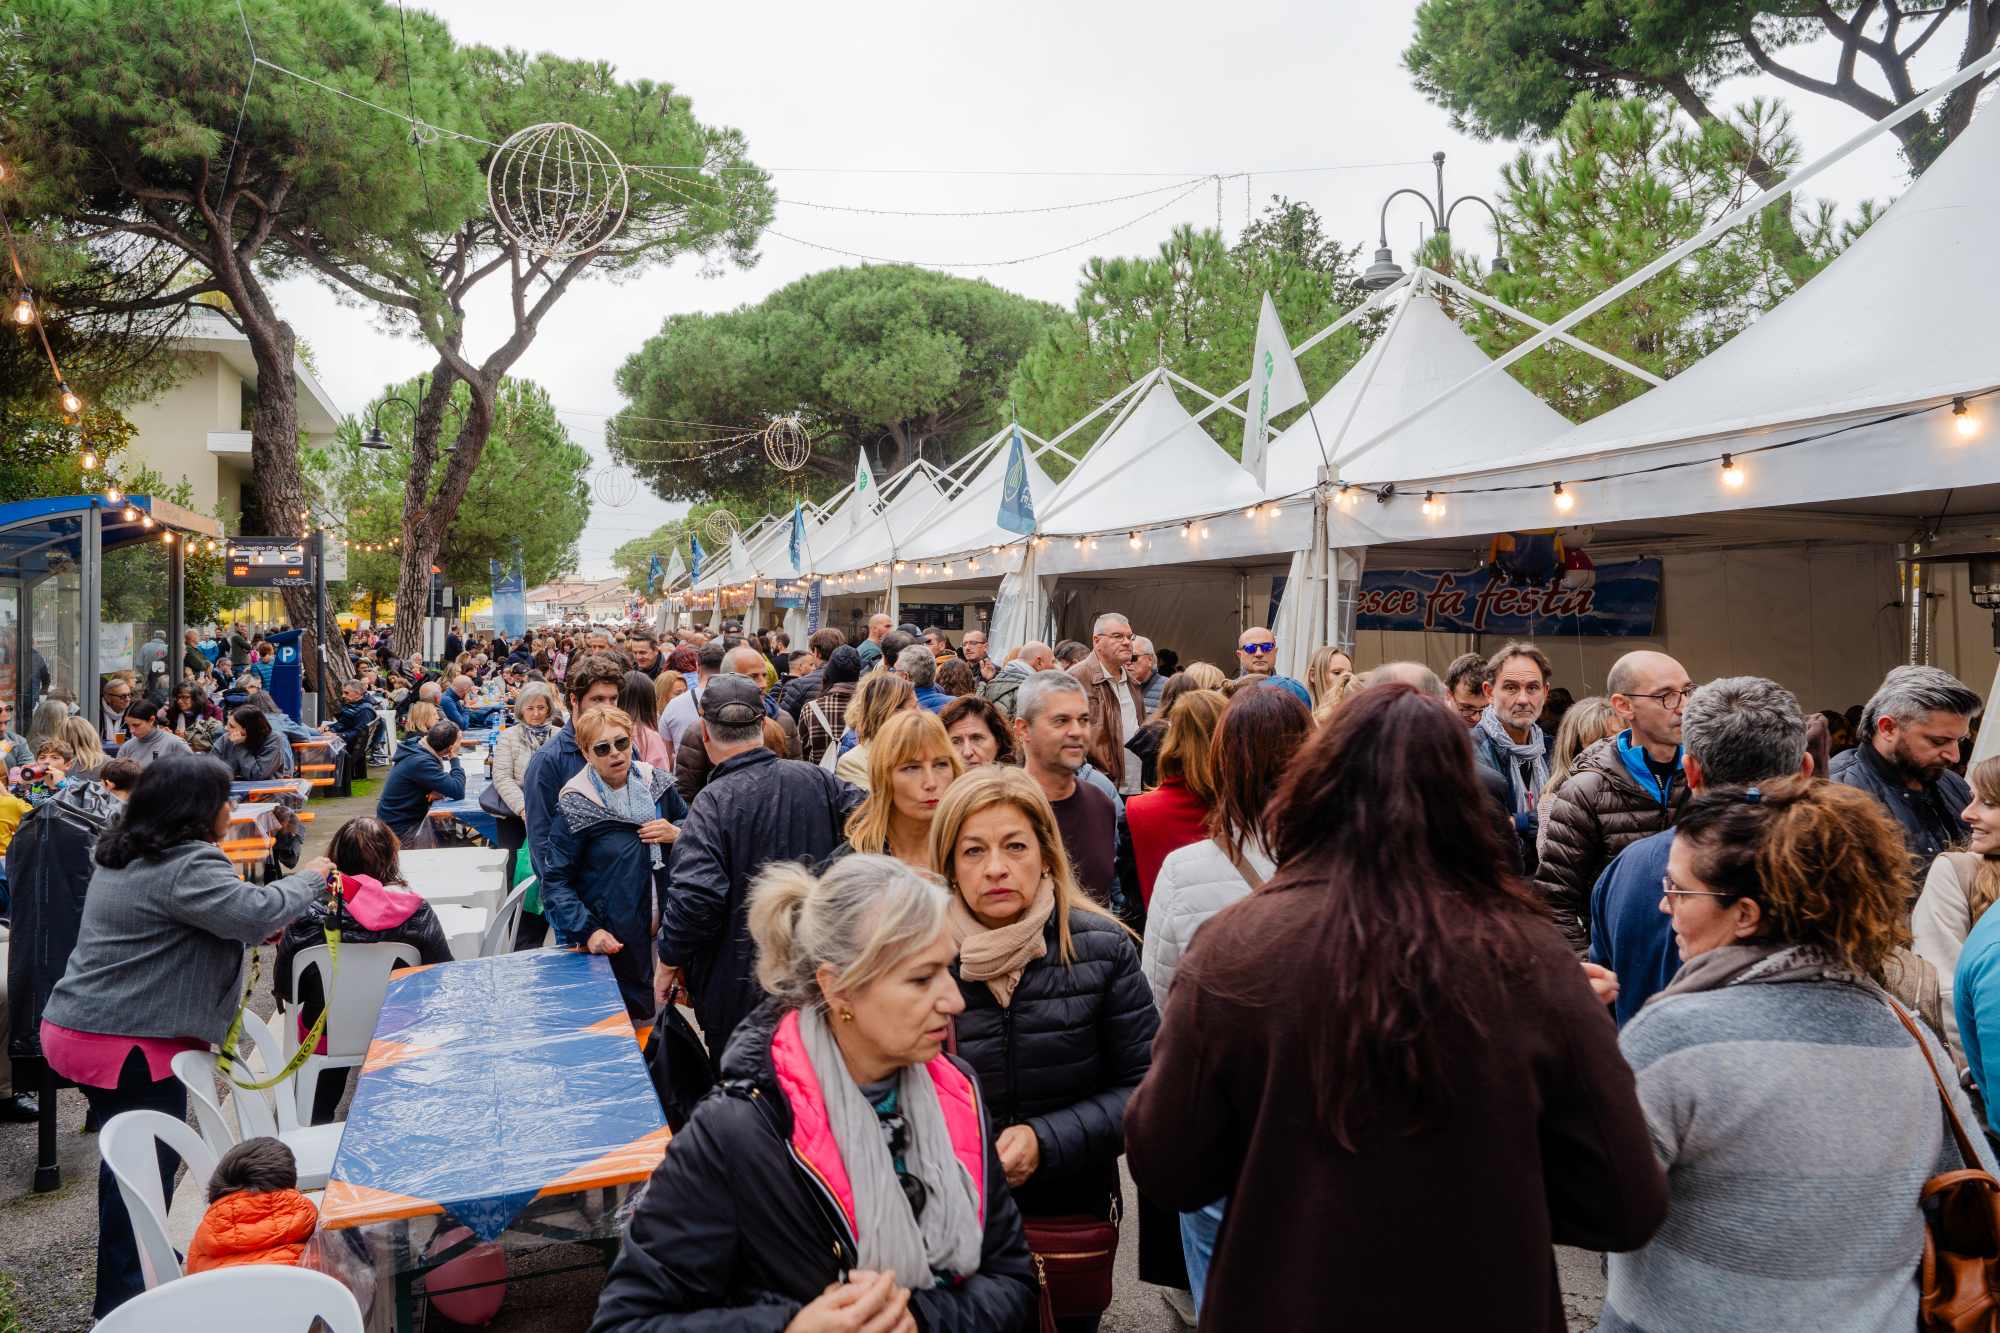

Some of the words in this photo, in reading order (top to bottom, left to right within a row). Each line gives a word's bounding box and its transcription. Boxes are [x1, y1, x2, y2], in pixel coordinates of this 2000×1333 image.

[1357, 590, 1417, 615] esce
[1425, 571, 1467, 630] fa
[1473, 575, 1595, 631] festa
[282, 646, 294, 662] P
